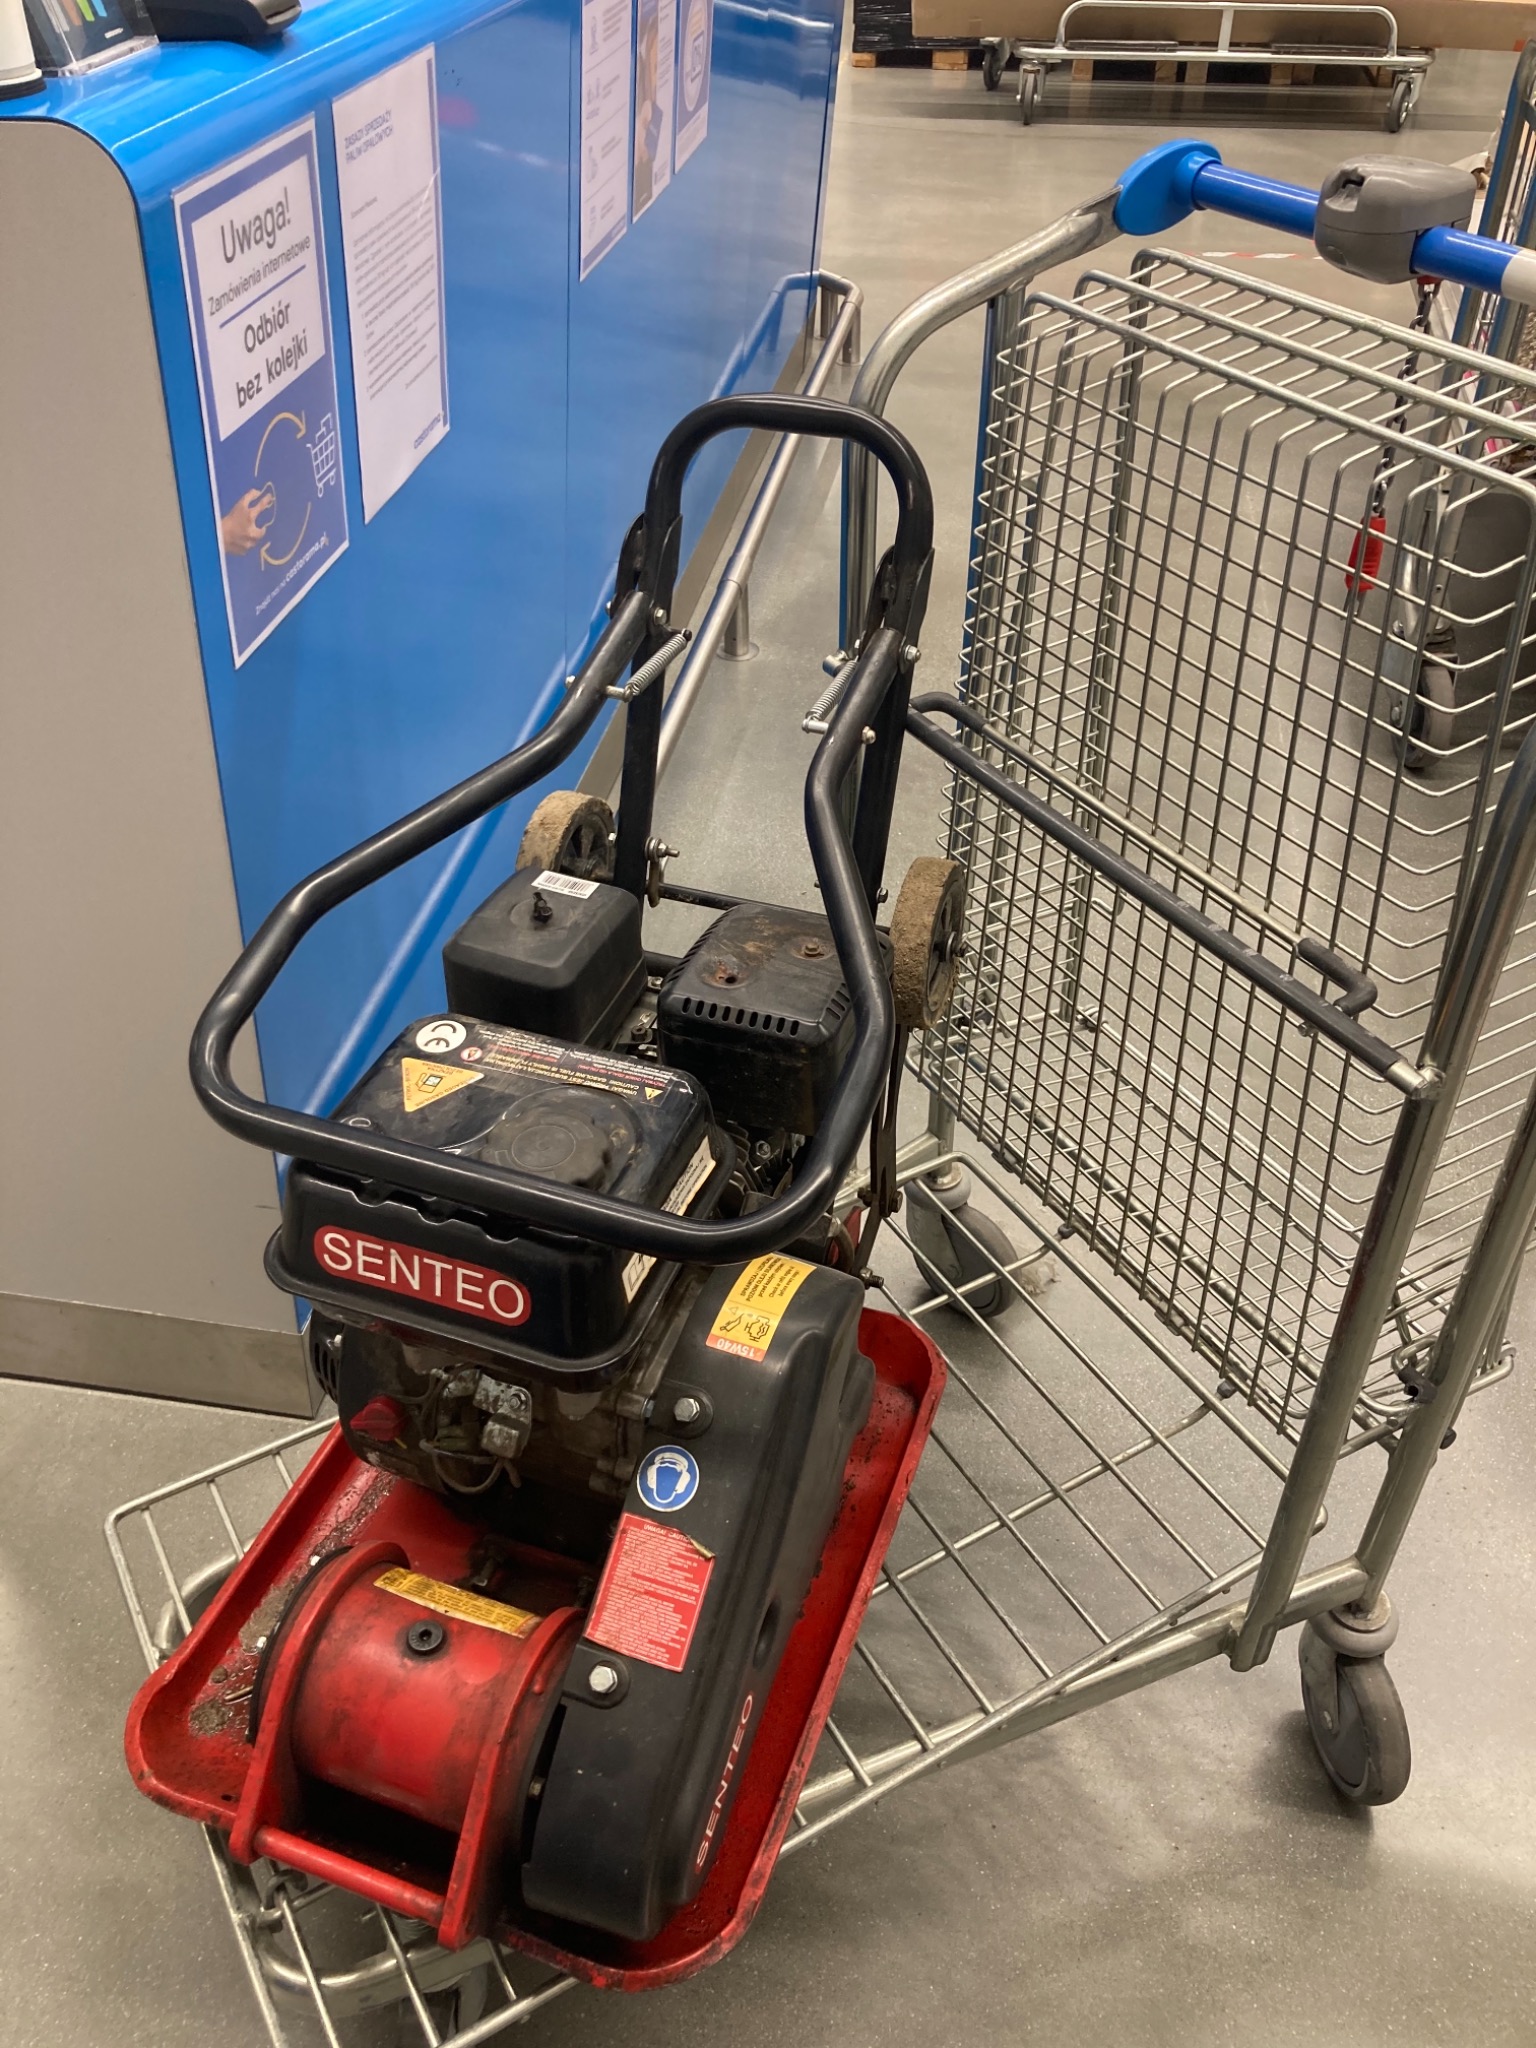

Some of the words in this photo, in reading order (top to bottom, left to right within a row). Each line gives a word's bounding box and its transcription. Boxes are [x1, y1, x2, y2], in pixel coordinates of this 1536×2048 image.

[220, 187, 291, 264] Uwaga!
[207, 266, 261, 317] Zamówienia
[262, 235, 310, 279] internetowe
[243, 300, 290, 354] Odbiór
[235, 371, 263, 409] bez
[265, 328, 308, 385] kolejki
[286, 531, 326, 581] castorama.pl
[574, 1071, 607, 1082] GASOLINE
[323, 1232, 524, 1319] SENTEO
[716, 1339, 755, 1357] 15W40
[696, 1694, 753, 1867] SENTEO
